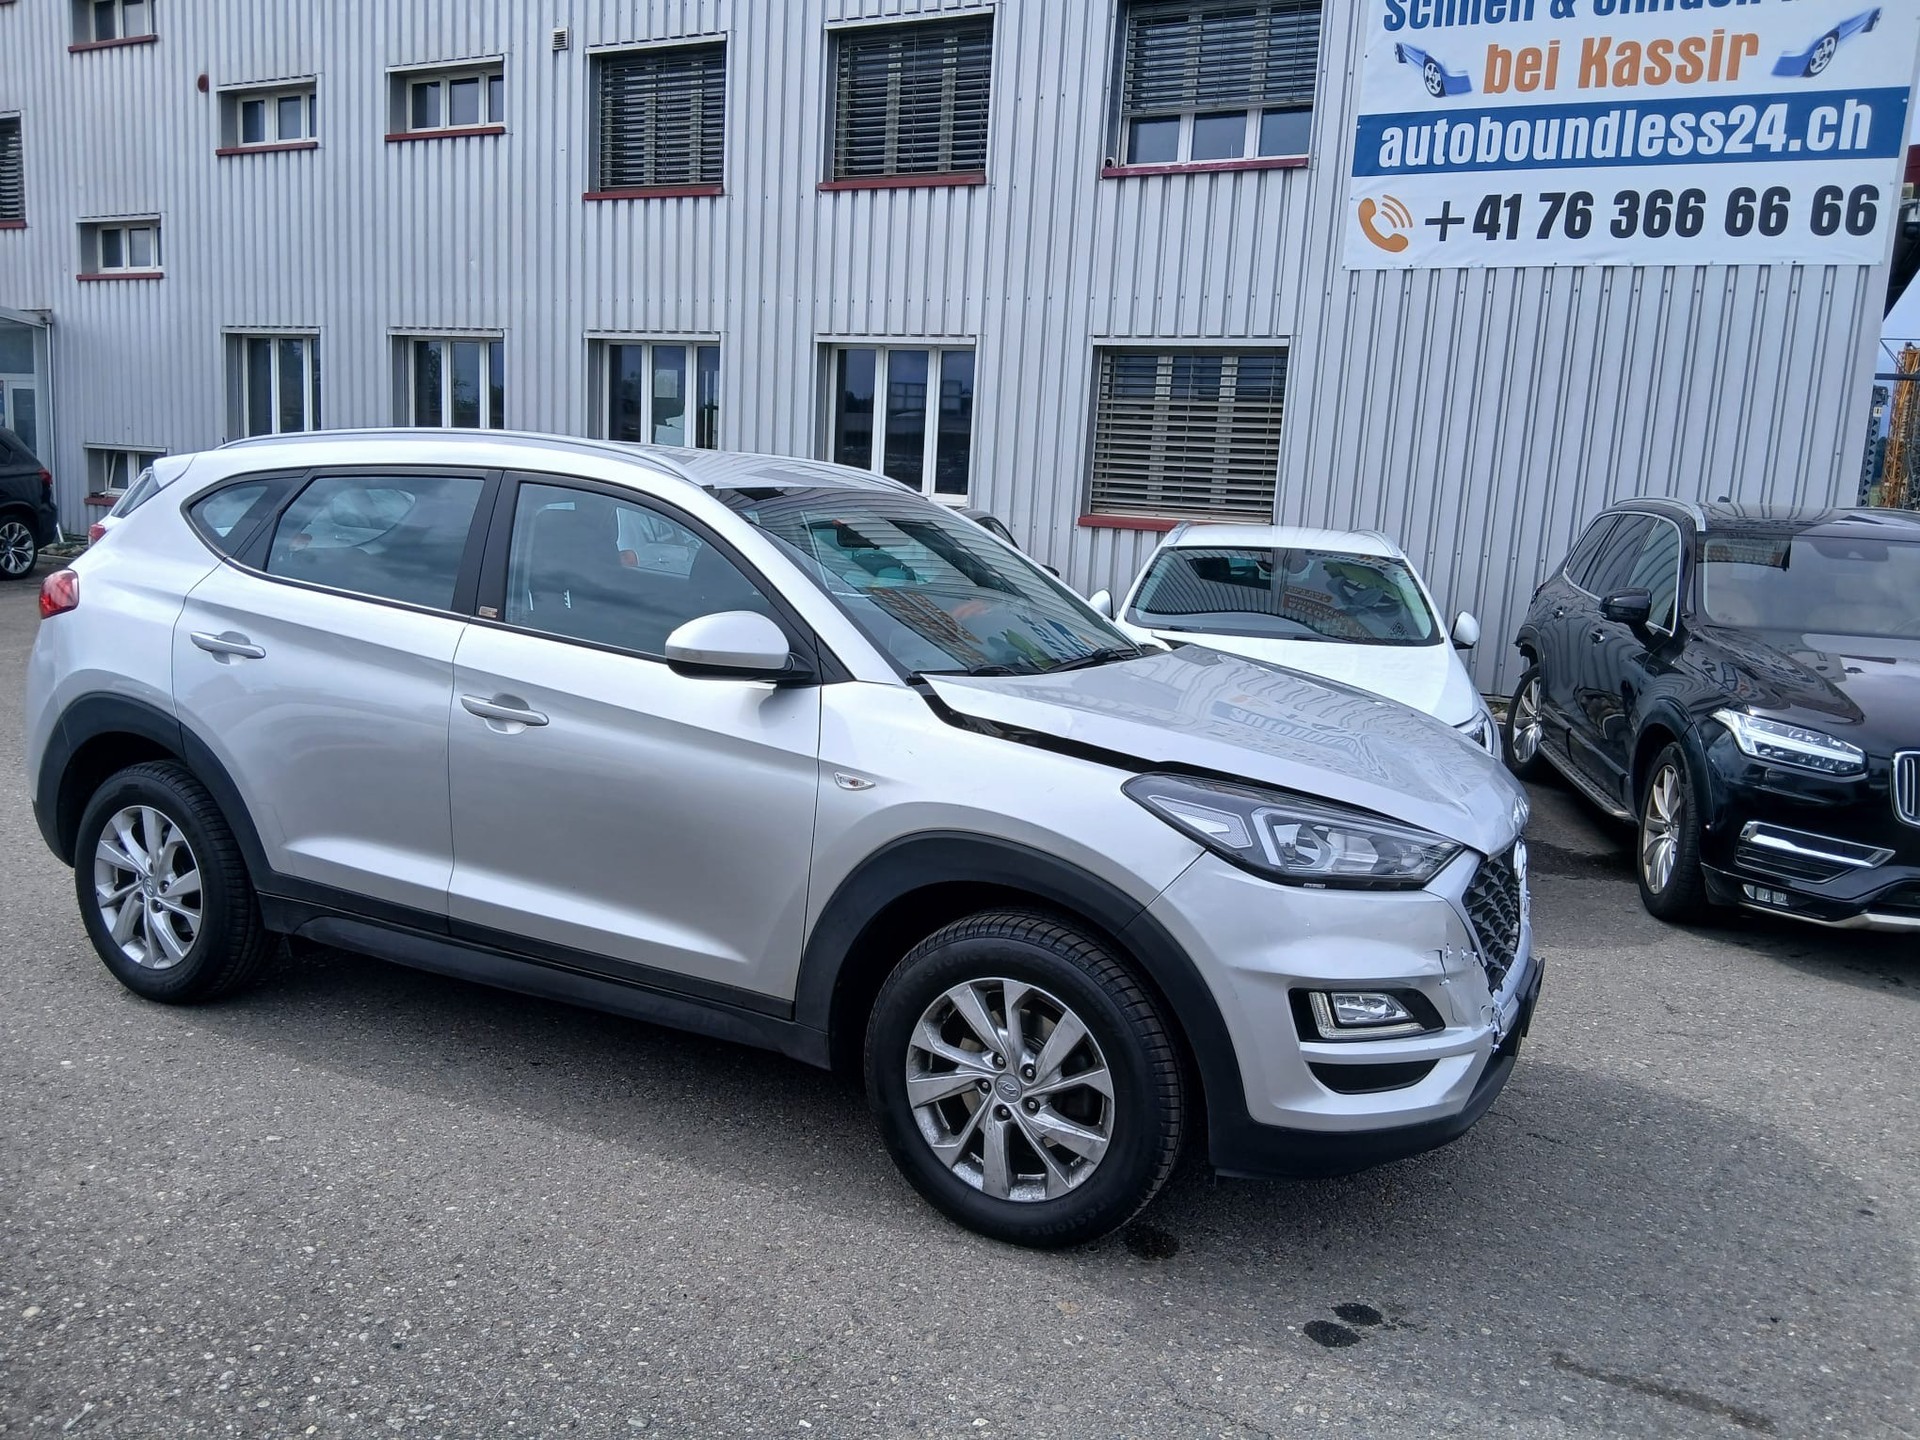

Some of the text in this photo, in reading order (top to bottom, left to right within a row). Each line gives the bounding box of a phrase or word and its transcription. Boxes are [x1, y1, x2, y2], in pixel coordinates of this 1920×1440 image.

[1484, 30, 1759, 94] bei Kassir
[1378, 99, 1872, 168] autoboundless24.ch
[1537, 192, 1594, 239] 76
[1610, 189, 1707, 239] 366
[1725, 186, 1791, 237] 66
[1810, 185, 1880, 237] 66
